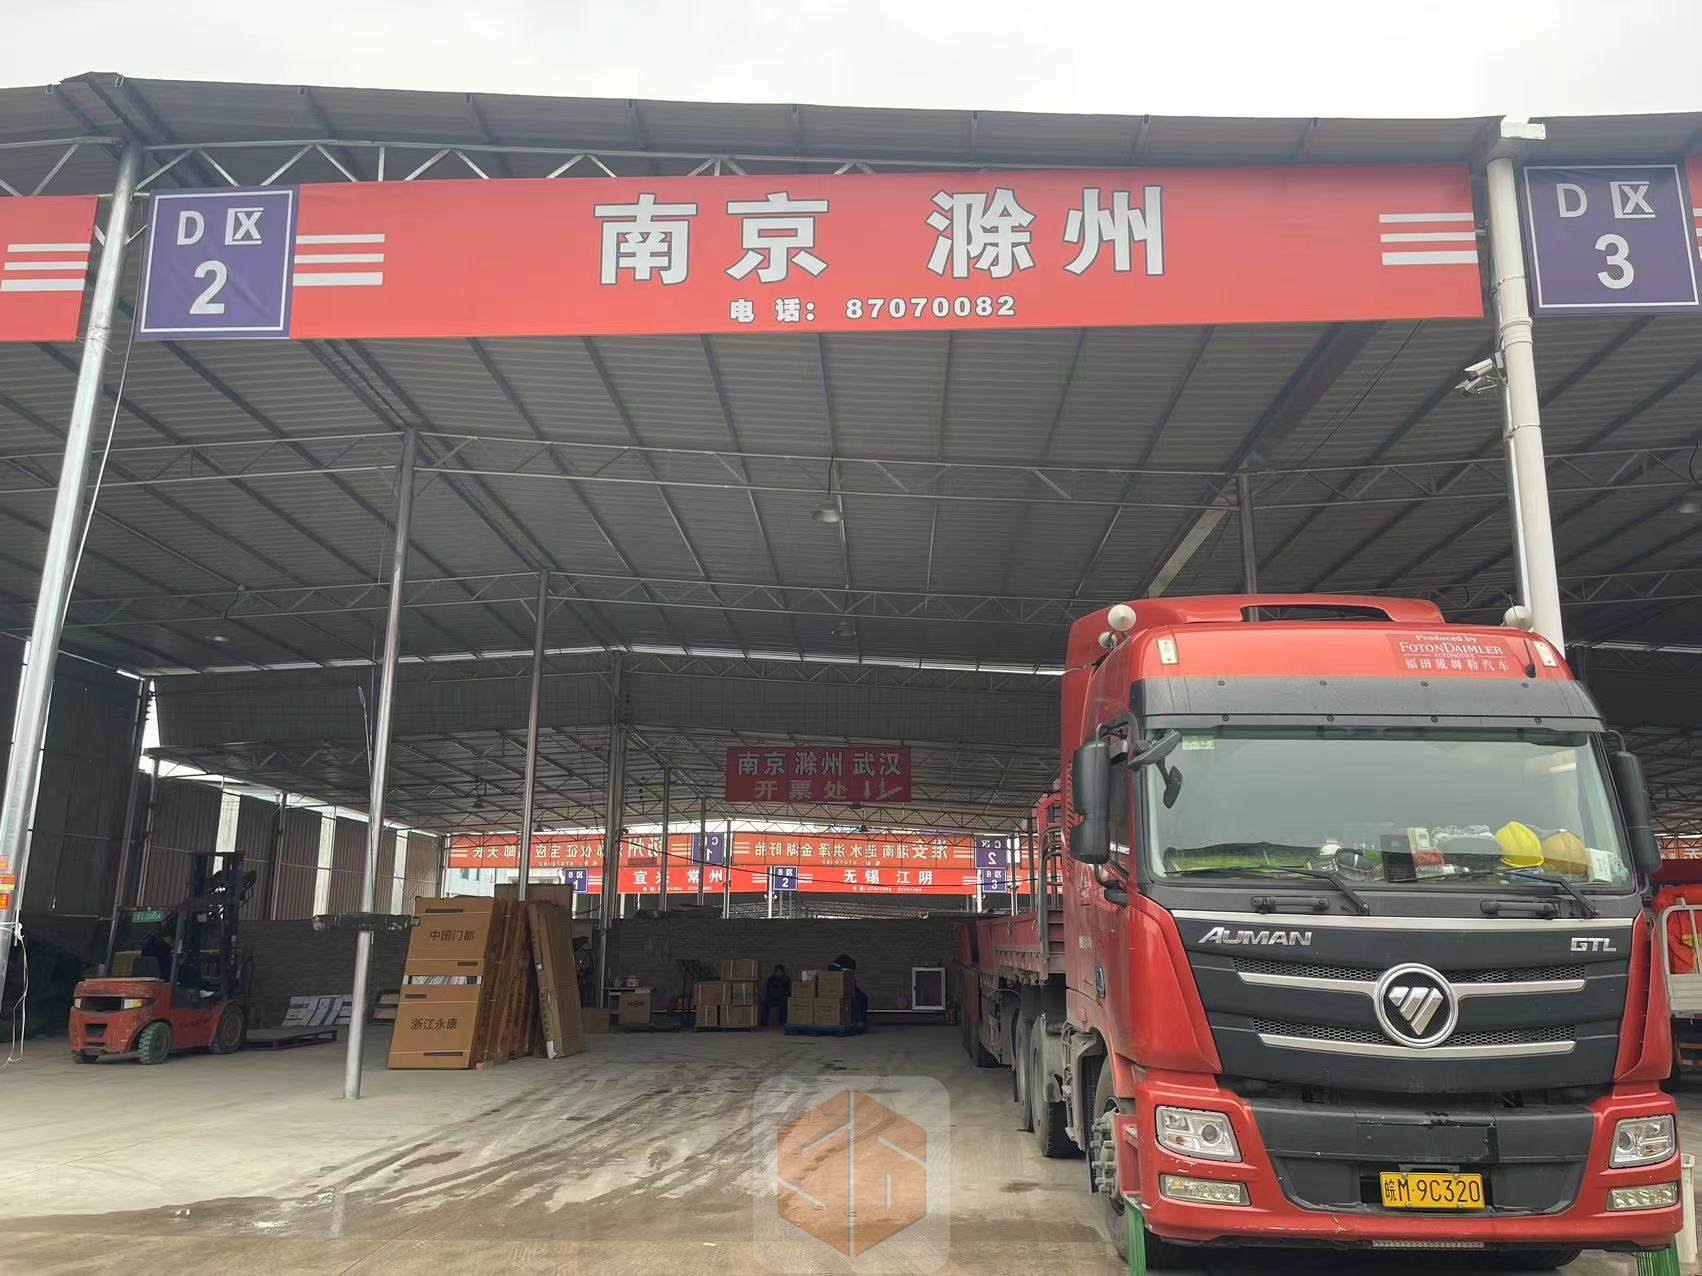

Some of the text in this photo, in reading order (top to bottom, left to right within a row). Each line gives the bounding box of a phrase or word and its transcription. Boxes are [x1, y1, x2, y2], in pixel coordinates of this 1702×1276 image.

[593, 186, 1165, 286] 南京 滁州
[1594, 234, 1635, 289] 3
[189, 260, 228, 315] 2
[845, 296, 1016, 319] 87070082
[1416, 634, 1464, 642] Produced
[738, 751, 901, 776] 南京 滁州 武汉
[755, 780, 848, 800] 开票处
[782, 877, 789, 888] 2
[991, 879, 998, 890] 3
[430, 929, 475, 941] 中国门都
[1198, 927, 1312, 946] AUMAN
[1570, 937, 1617, 952] GTL
[410, 1018, 458, 1030] 浙江永康
